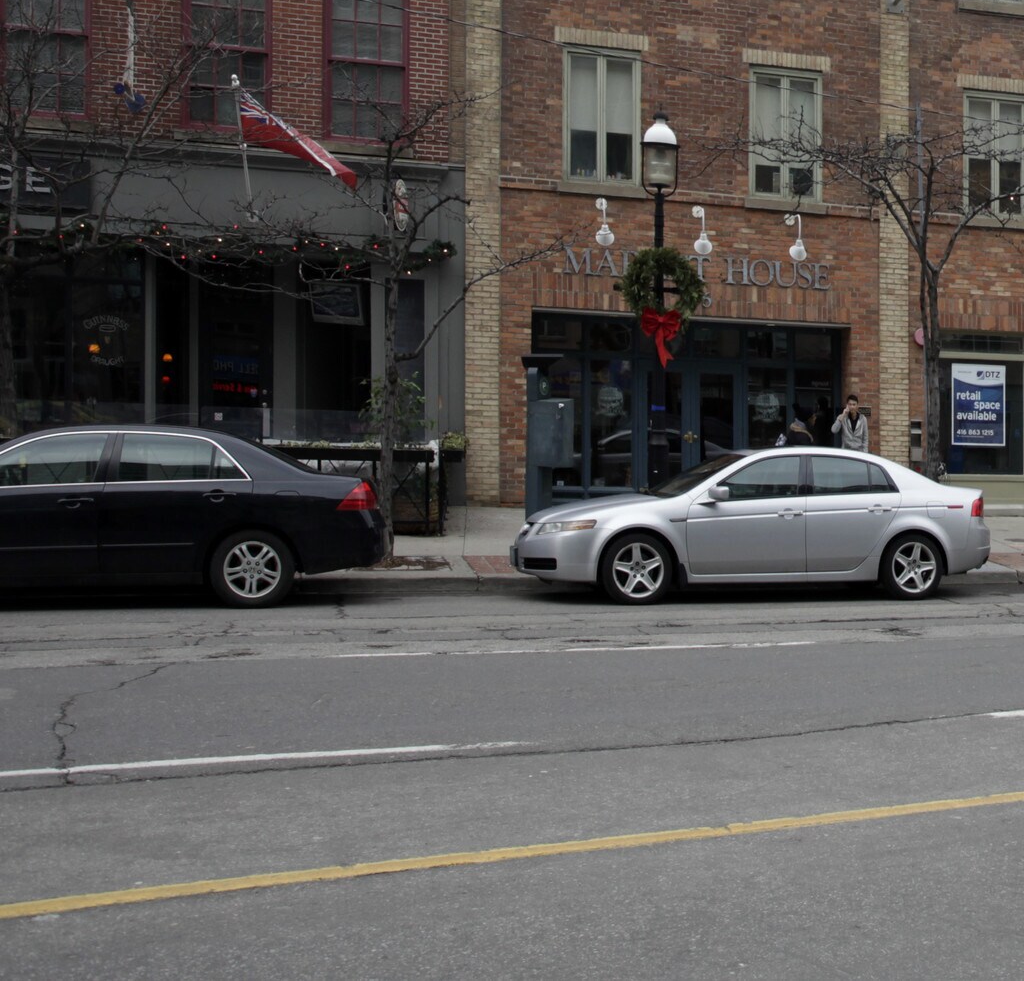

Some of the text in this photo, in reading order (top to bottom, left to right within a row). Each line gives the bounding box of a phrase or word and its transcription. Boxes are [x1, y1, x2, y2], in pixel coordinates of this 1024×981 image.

[724, 257, 832, 291] HOUSE
[83, 315, 130, 331] GUINNESS
[985, 370, 1000, 378] DTZ
[956, 391, 981, 400] retail
[974, 401, 1001, 411] space
[956, 410, 997, 421] available
